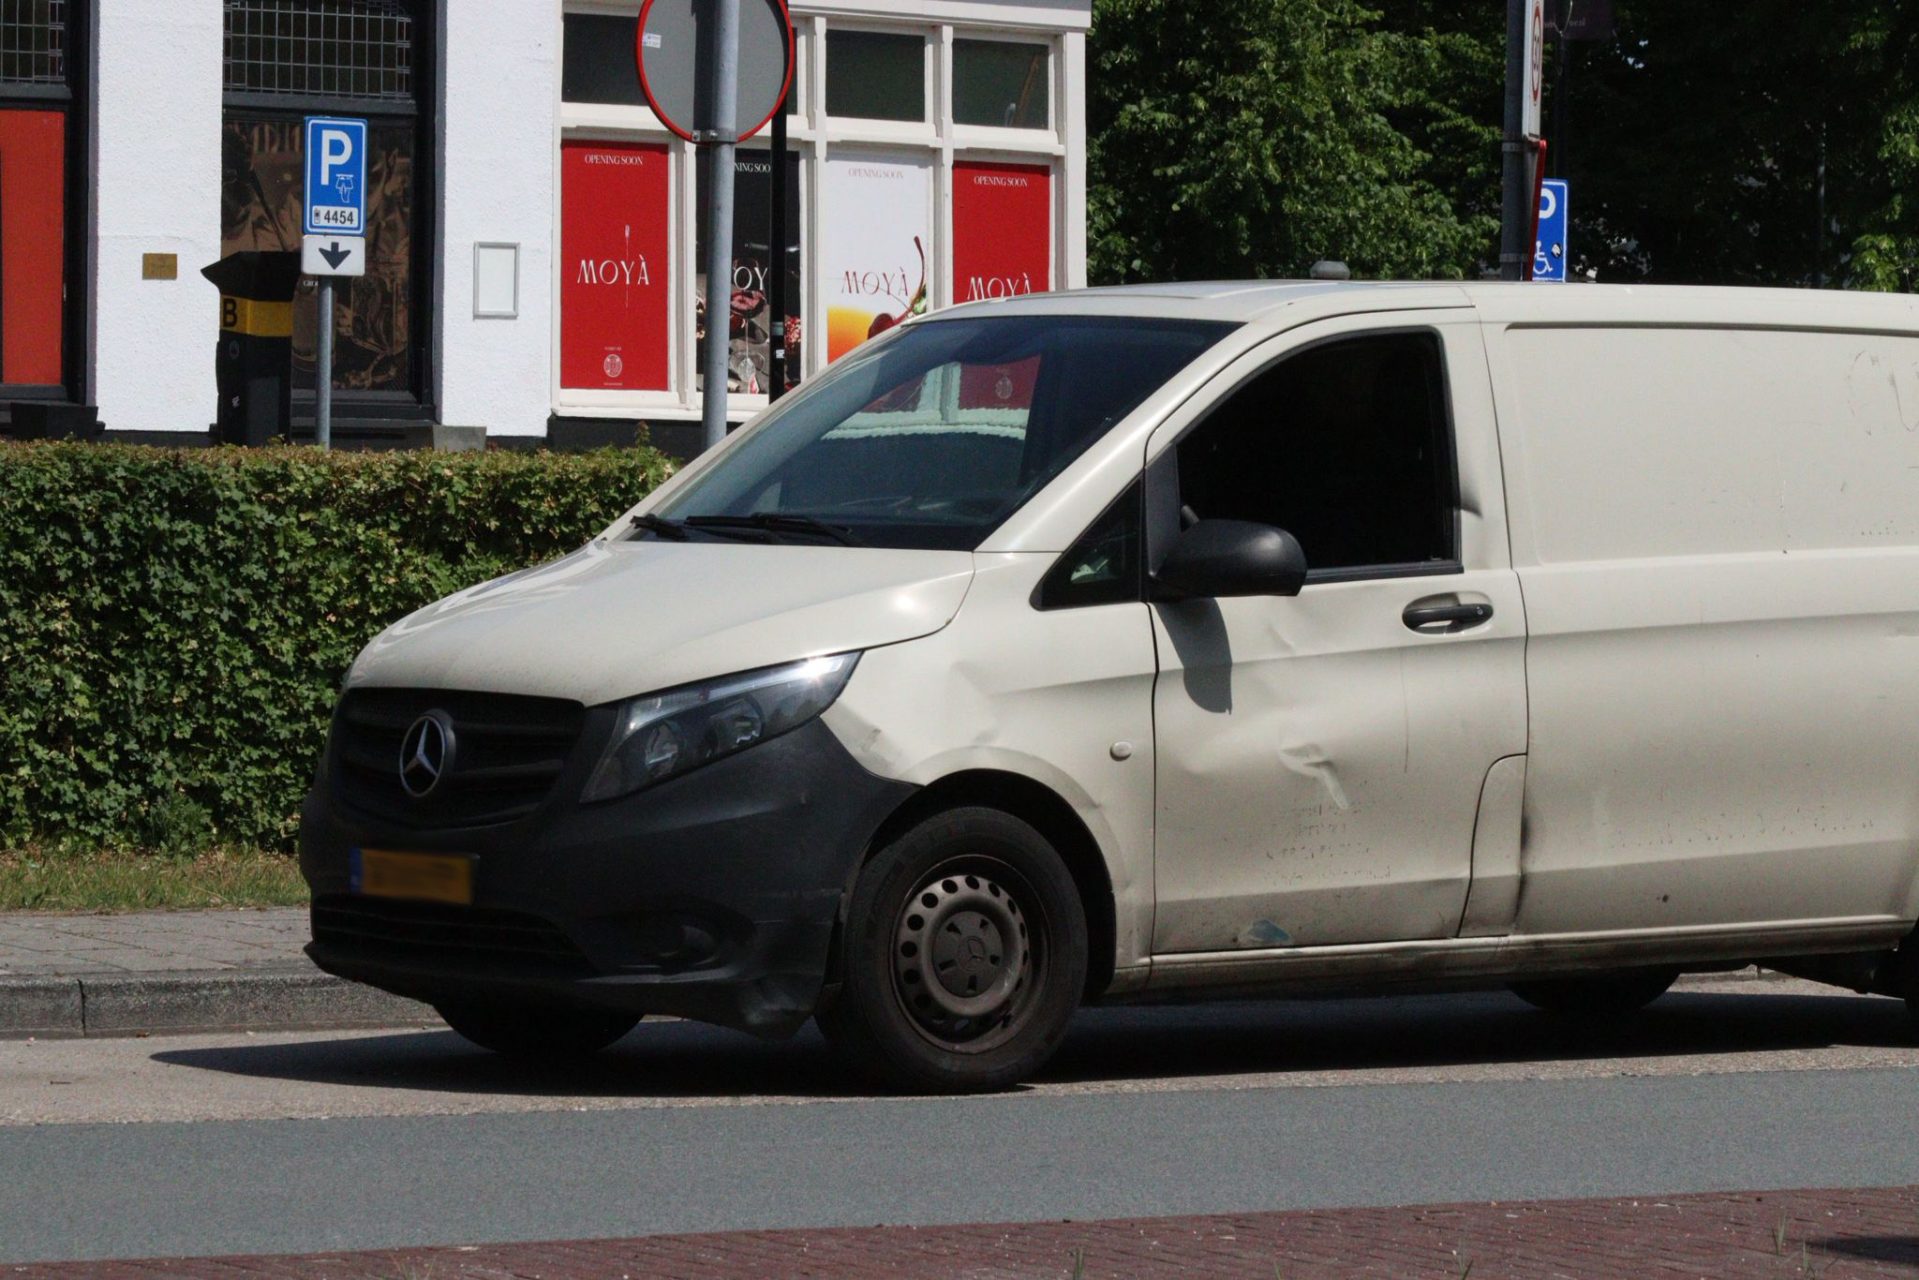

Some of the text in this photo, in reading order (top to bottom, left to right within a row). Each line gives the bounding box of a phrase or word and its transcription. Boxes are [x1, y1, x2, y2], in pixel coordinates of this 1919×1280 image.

[321, 130, 352, 186] P
[584, 154, 644, 165] OPENING SOON
[735, 162, 771, 173] NING SOO
[848, 167, 904, 179] OPENING SOON
[973, 175, 1028, 187] OPENING SOON
[324, 210, 354, 225] 4454
[577, 253, 650, 285] MOYÀ
[733, 265, 768, 291] OY
[841, 265, 909, 297] MOYÀ
[967, 271, 1031, 300] MOYÀ
[222, 298, 238, 328] B
